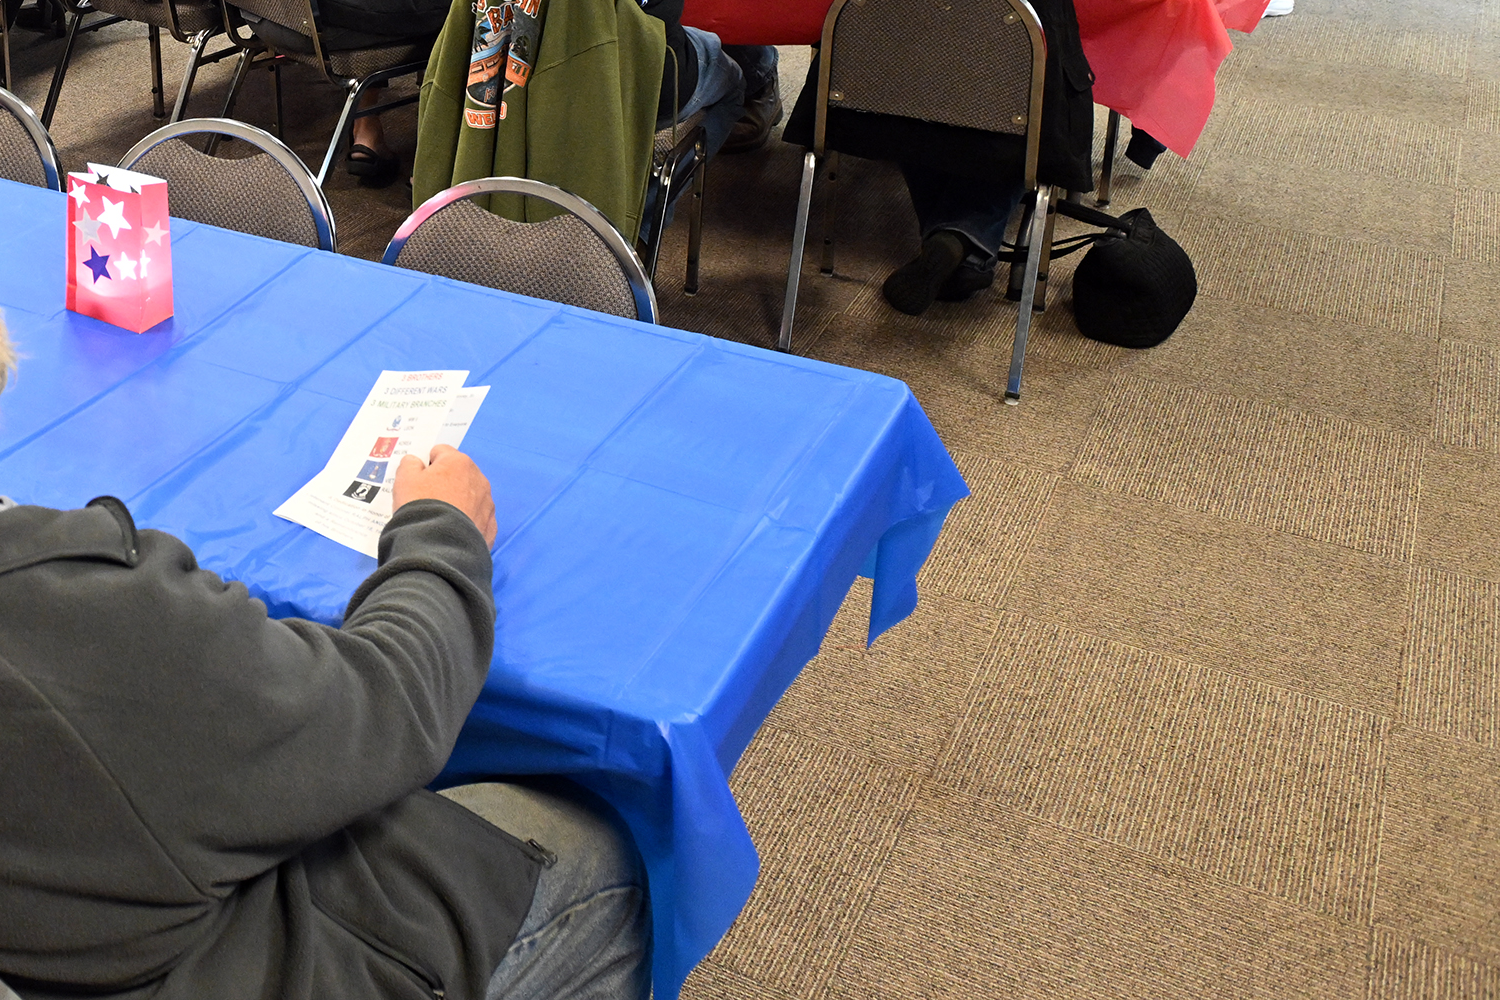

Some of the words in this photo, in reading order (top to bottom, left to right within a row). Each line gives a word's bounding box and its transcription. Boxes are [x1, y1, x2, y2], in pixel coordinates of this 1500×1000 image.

[406, 372, 444, 381] BROTHERS
[390, 386, 426, 396] DIFFERENT
[426, 385, 448, 394] WARS
[377, 399, 409, 409] MILITARY
[410, 399, 448, 409] BRANCHES
